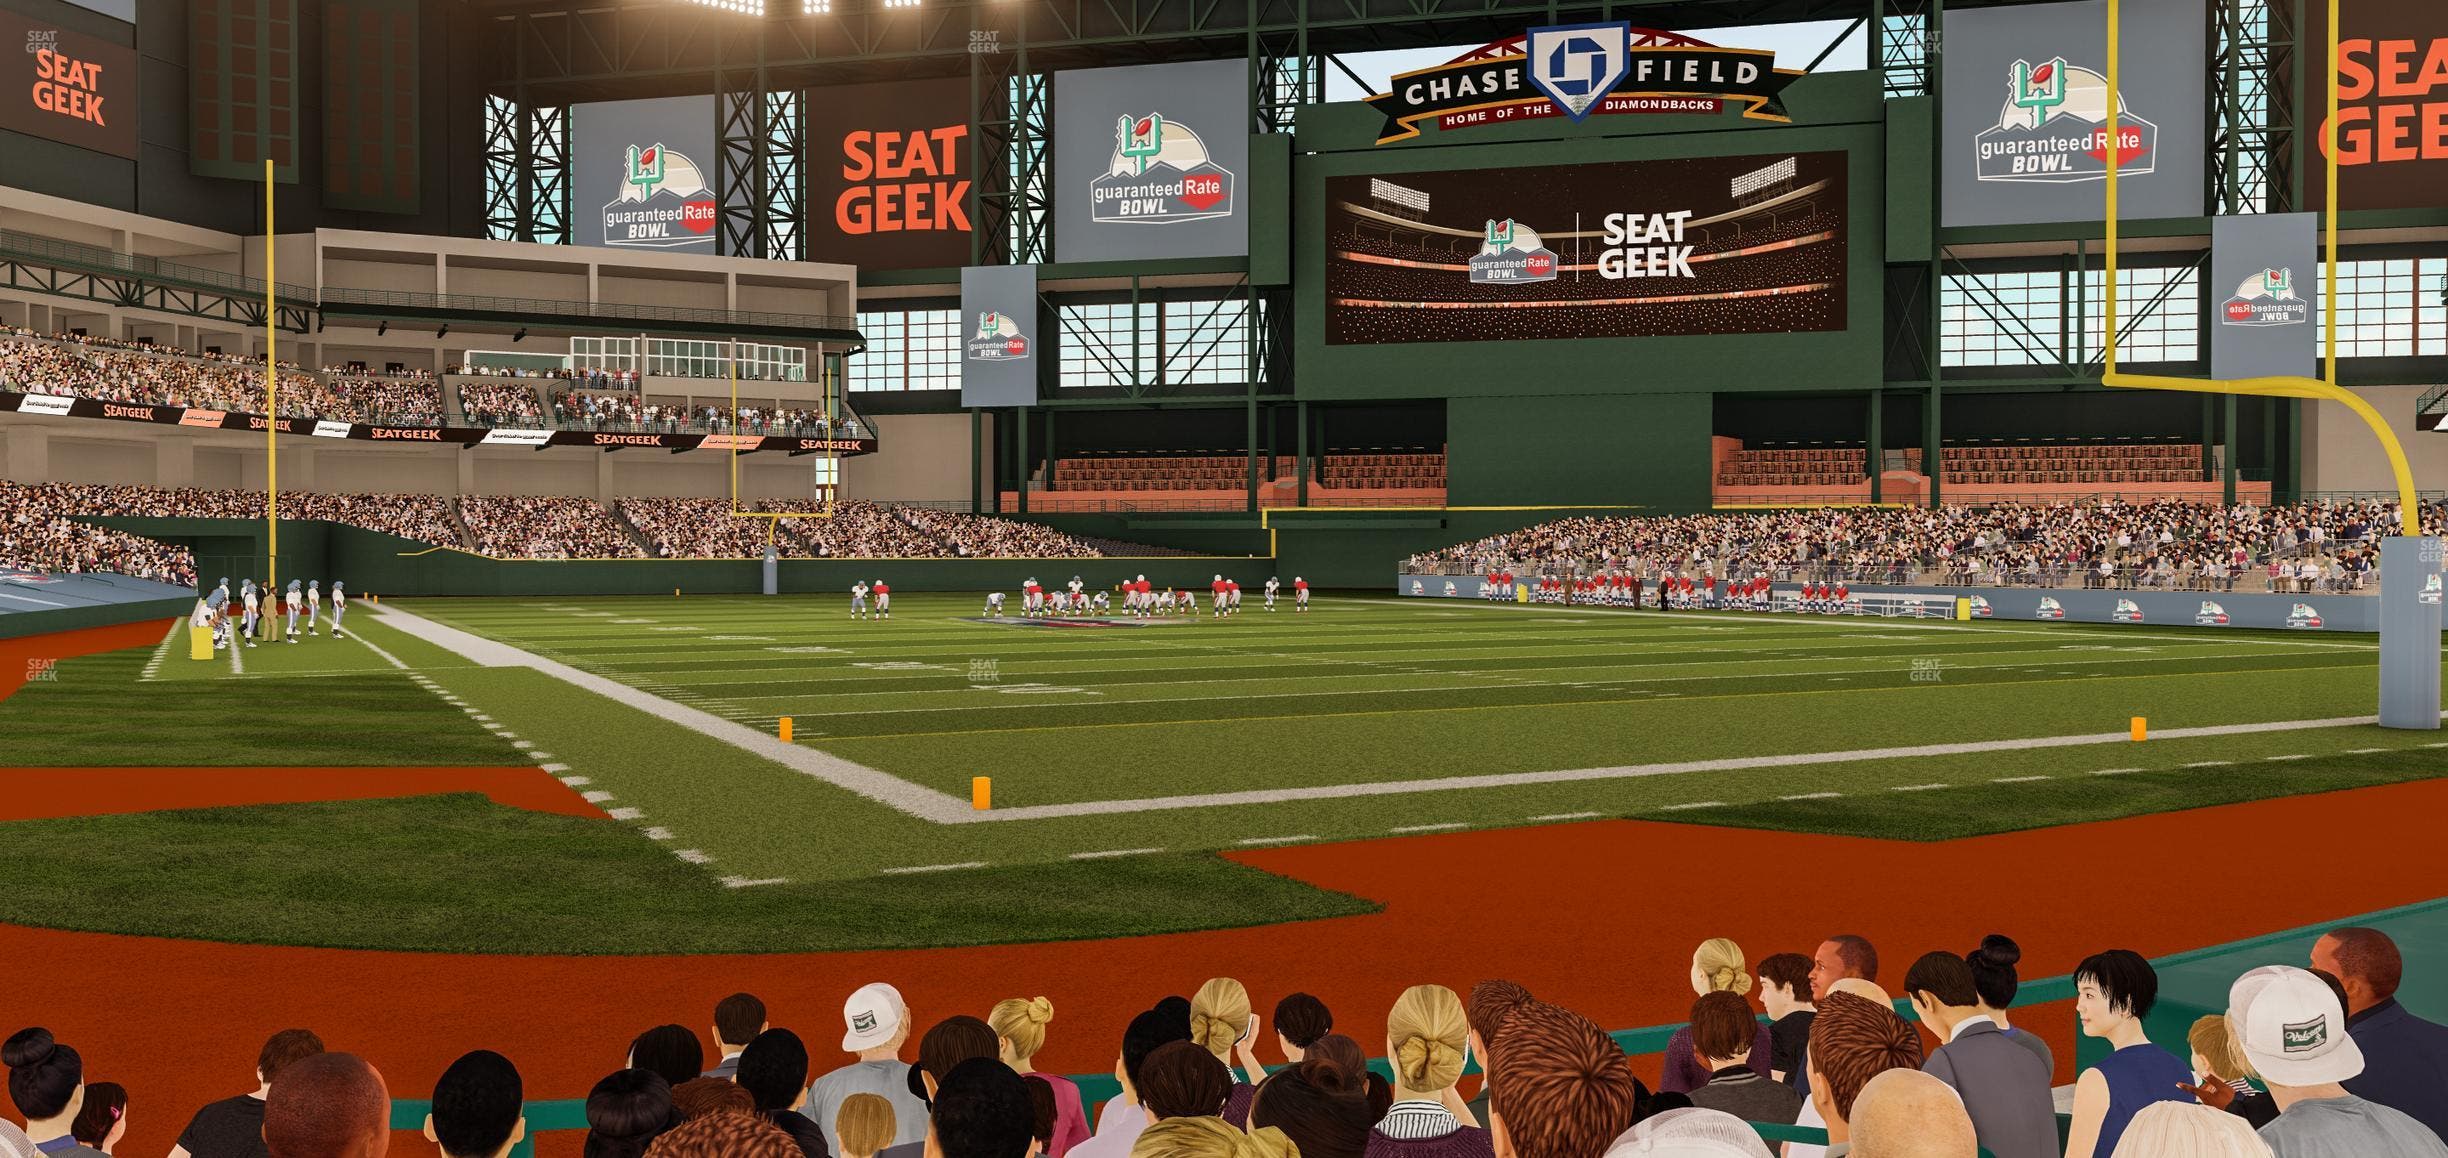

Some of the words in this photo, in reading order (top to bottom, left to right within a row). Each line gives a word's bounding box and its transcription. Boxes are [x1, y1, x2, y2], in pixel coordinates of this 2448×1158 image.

[36, 48, 102, 92] SEAT
[2337, 37, 2448, 101] SEA
[1404, 68, 1520, 106] CHASE
[1637, 60, 1758, 84] FIELD
[32, 81, 105, 127] GEEK
[1446, 111, 1487, 126] HOME
[1496, 107, 1515, 119] OF
[1523, 103, 1553, 117] THE
[1604, 98, 1715, 111] DIAMONDBACKS
[2318, 101, 2448, 166] GEE
[843, 124, 968, 182] SEAT
[1980, 133, 2093, 160] guaranteed
[2012, 154, 2073, 174] BOWL
[1094, 180, 1183, 203] guaranteed
[1185, 179, 1220, 195] Rate
[606, 205, 683, 228] guaranteed
[685, 205, 715, 220] Rate
[835, 180, 973, 235] GEEK
[1119, 198, 1168, 215] BOWL
[628, 222, 670, 239] BOWL
[1603, 209, 1692, 246] SEAT
[1471, 258, 1527, 273] guaranteed
[1528, 257, 1550, 268] Rate
[1487, 267, 1517, 279] BOWL
[1597, 245, 1696, 280] GEEK
[103, 404, 154, 421] SEATGEEK
[250, 416, 292, 432] SEATEEK
[371, 428, 441, 441] SEATGEEK
[594, 434, 662, 446] SEATGEEK
